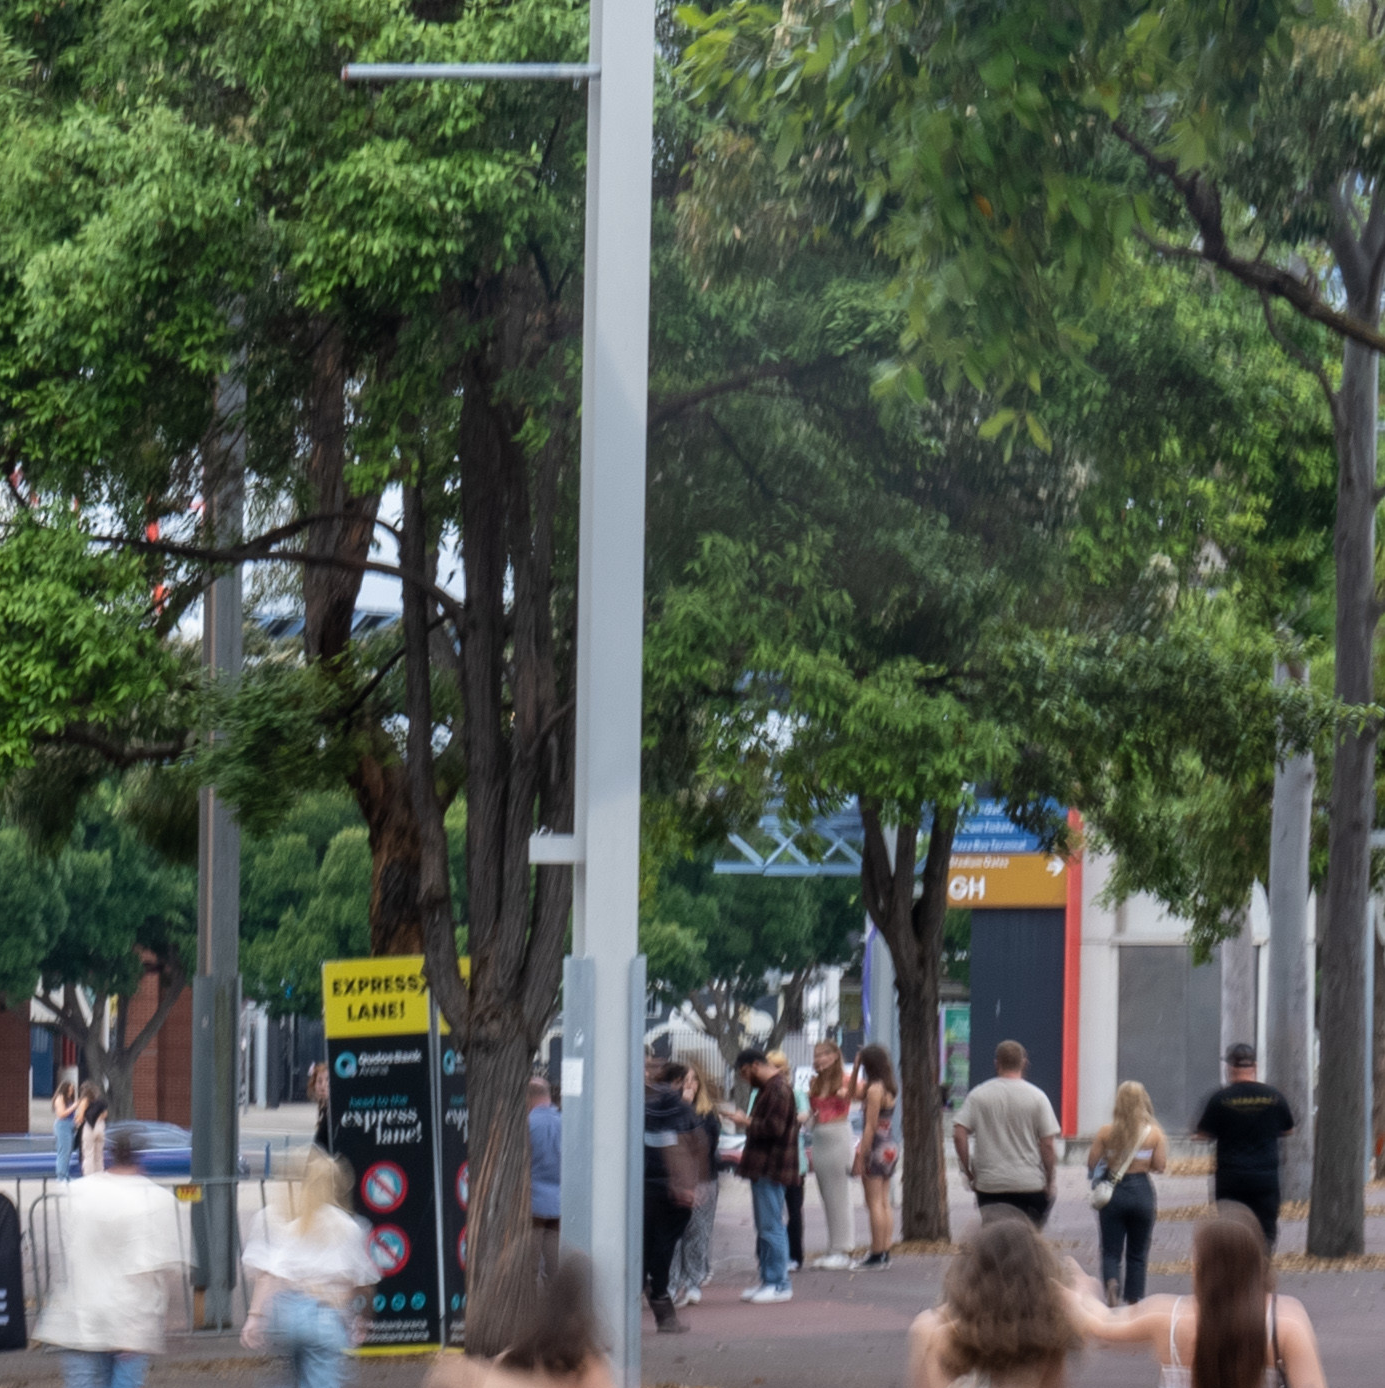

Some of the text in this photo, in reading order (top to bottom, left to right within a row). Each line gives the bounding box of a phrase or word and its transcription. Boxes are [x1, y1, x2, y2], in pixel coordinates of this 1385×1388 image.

[332, 974, 419, 997] EXPRESS
[347, 1000, 405, 1022] LANE!
[341, 1107, 418, 1134] express
[376, 1120, 422, 1146] lane!
